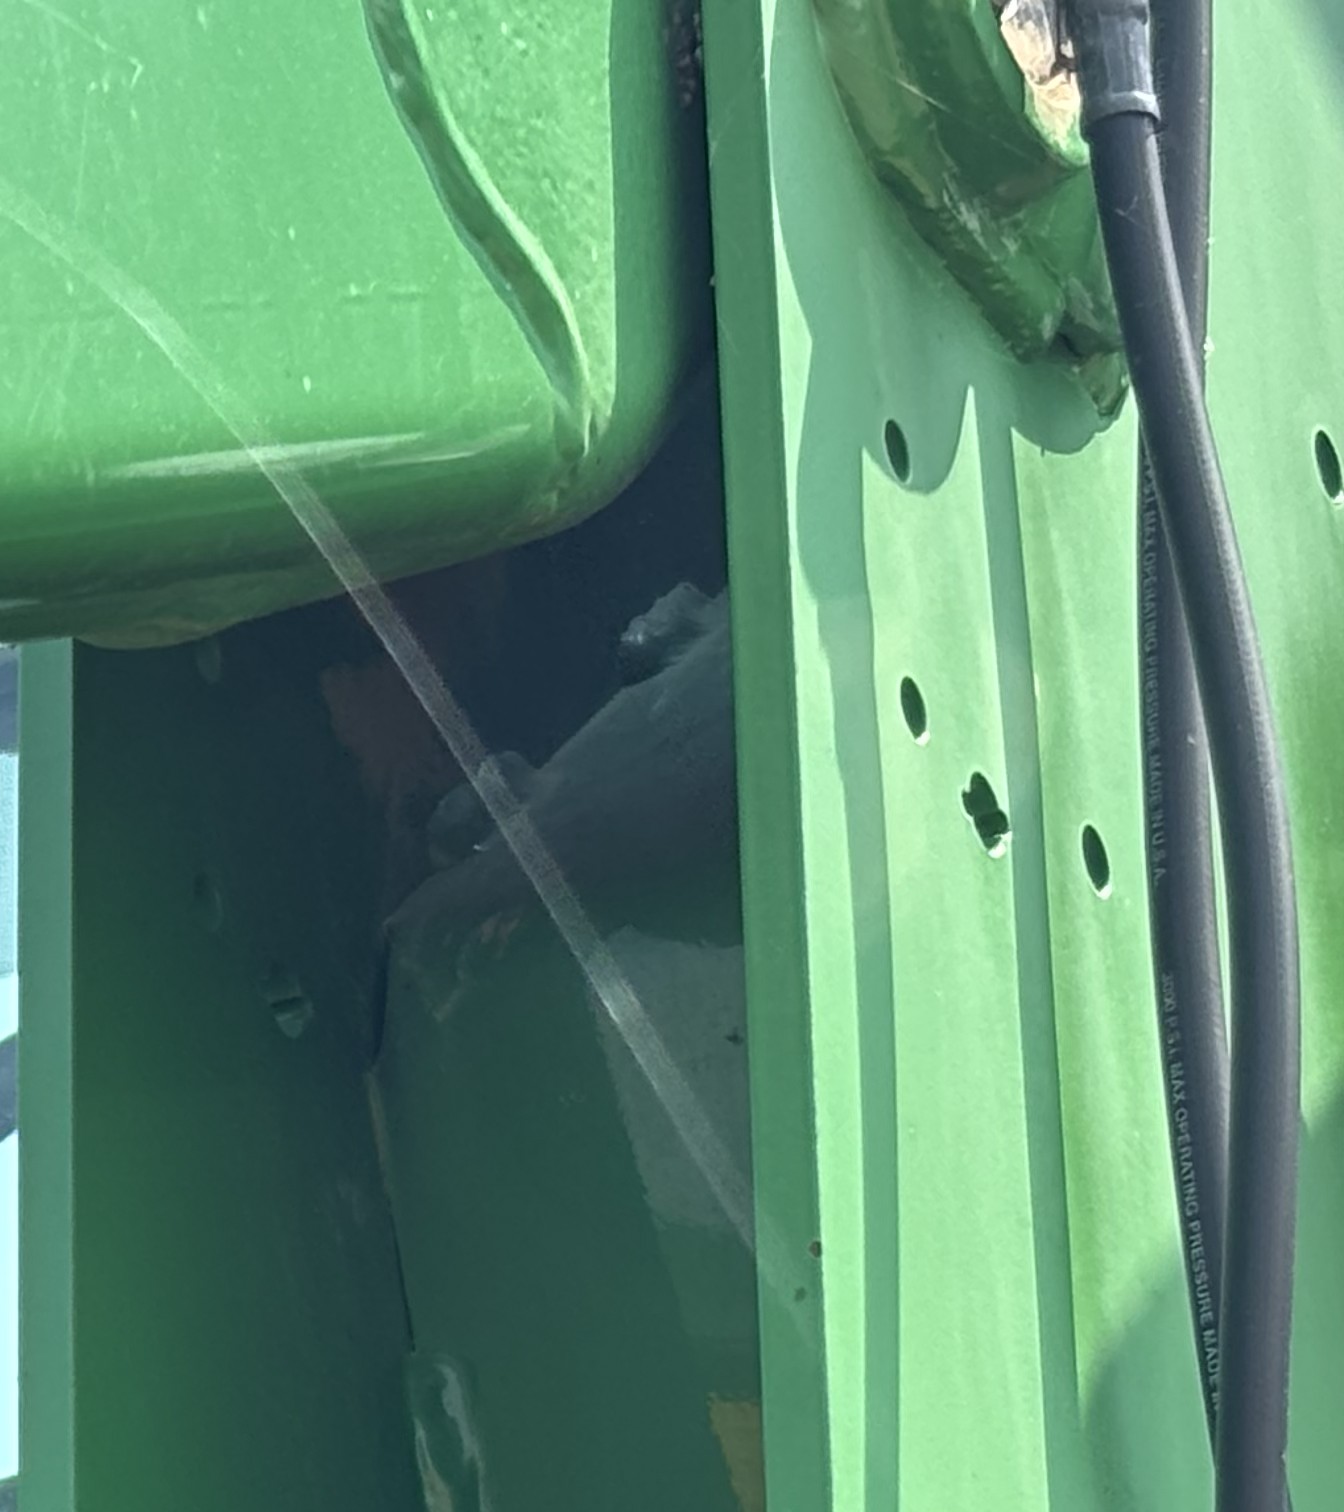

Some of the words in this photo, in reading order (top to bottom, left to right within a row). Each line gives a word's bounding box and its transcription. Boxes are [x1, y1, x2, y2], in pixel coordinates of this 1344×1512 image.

[1143, 550, 1158, 651] OPERATING
[1144, 655, 1161, 750] PRESSURE
[1148, 752, 1164, 804] MADE
[1169, 1061, 1187, 1104] MAX
[1174, 1107, 1200, 1216] OPERATING
[1188, 1219, 1215, 1325] PRESSURE
